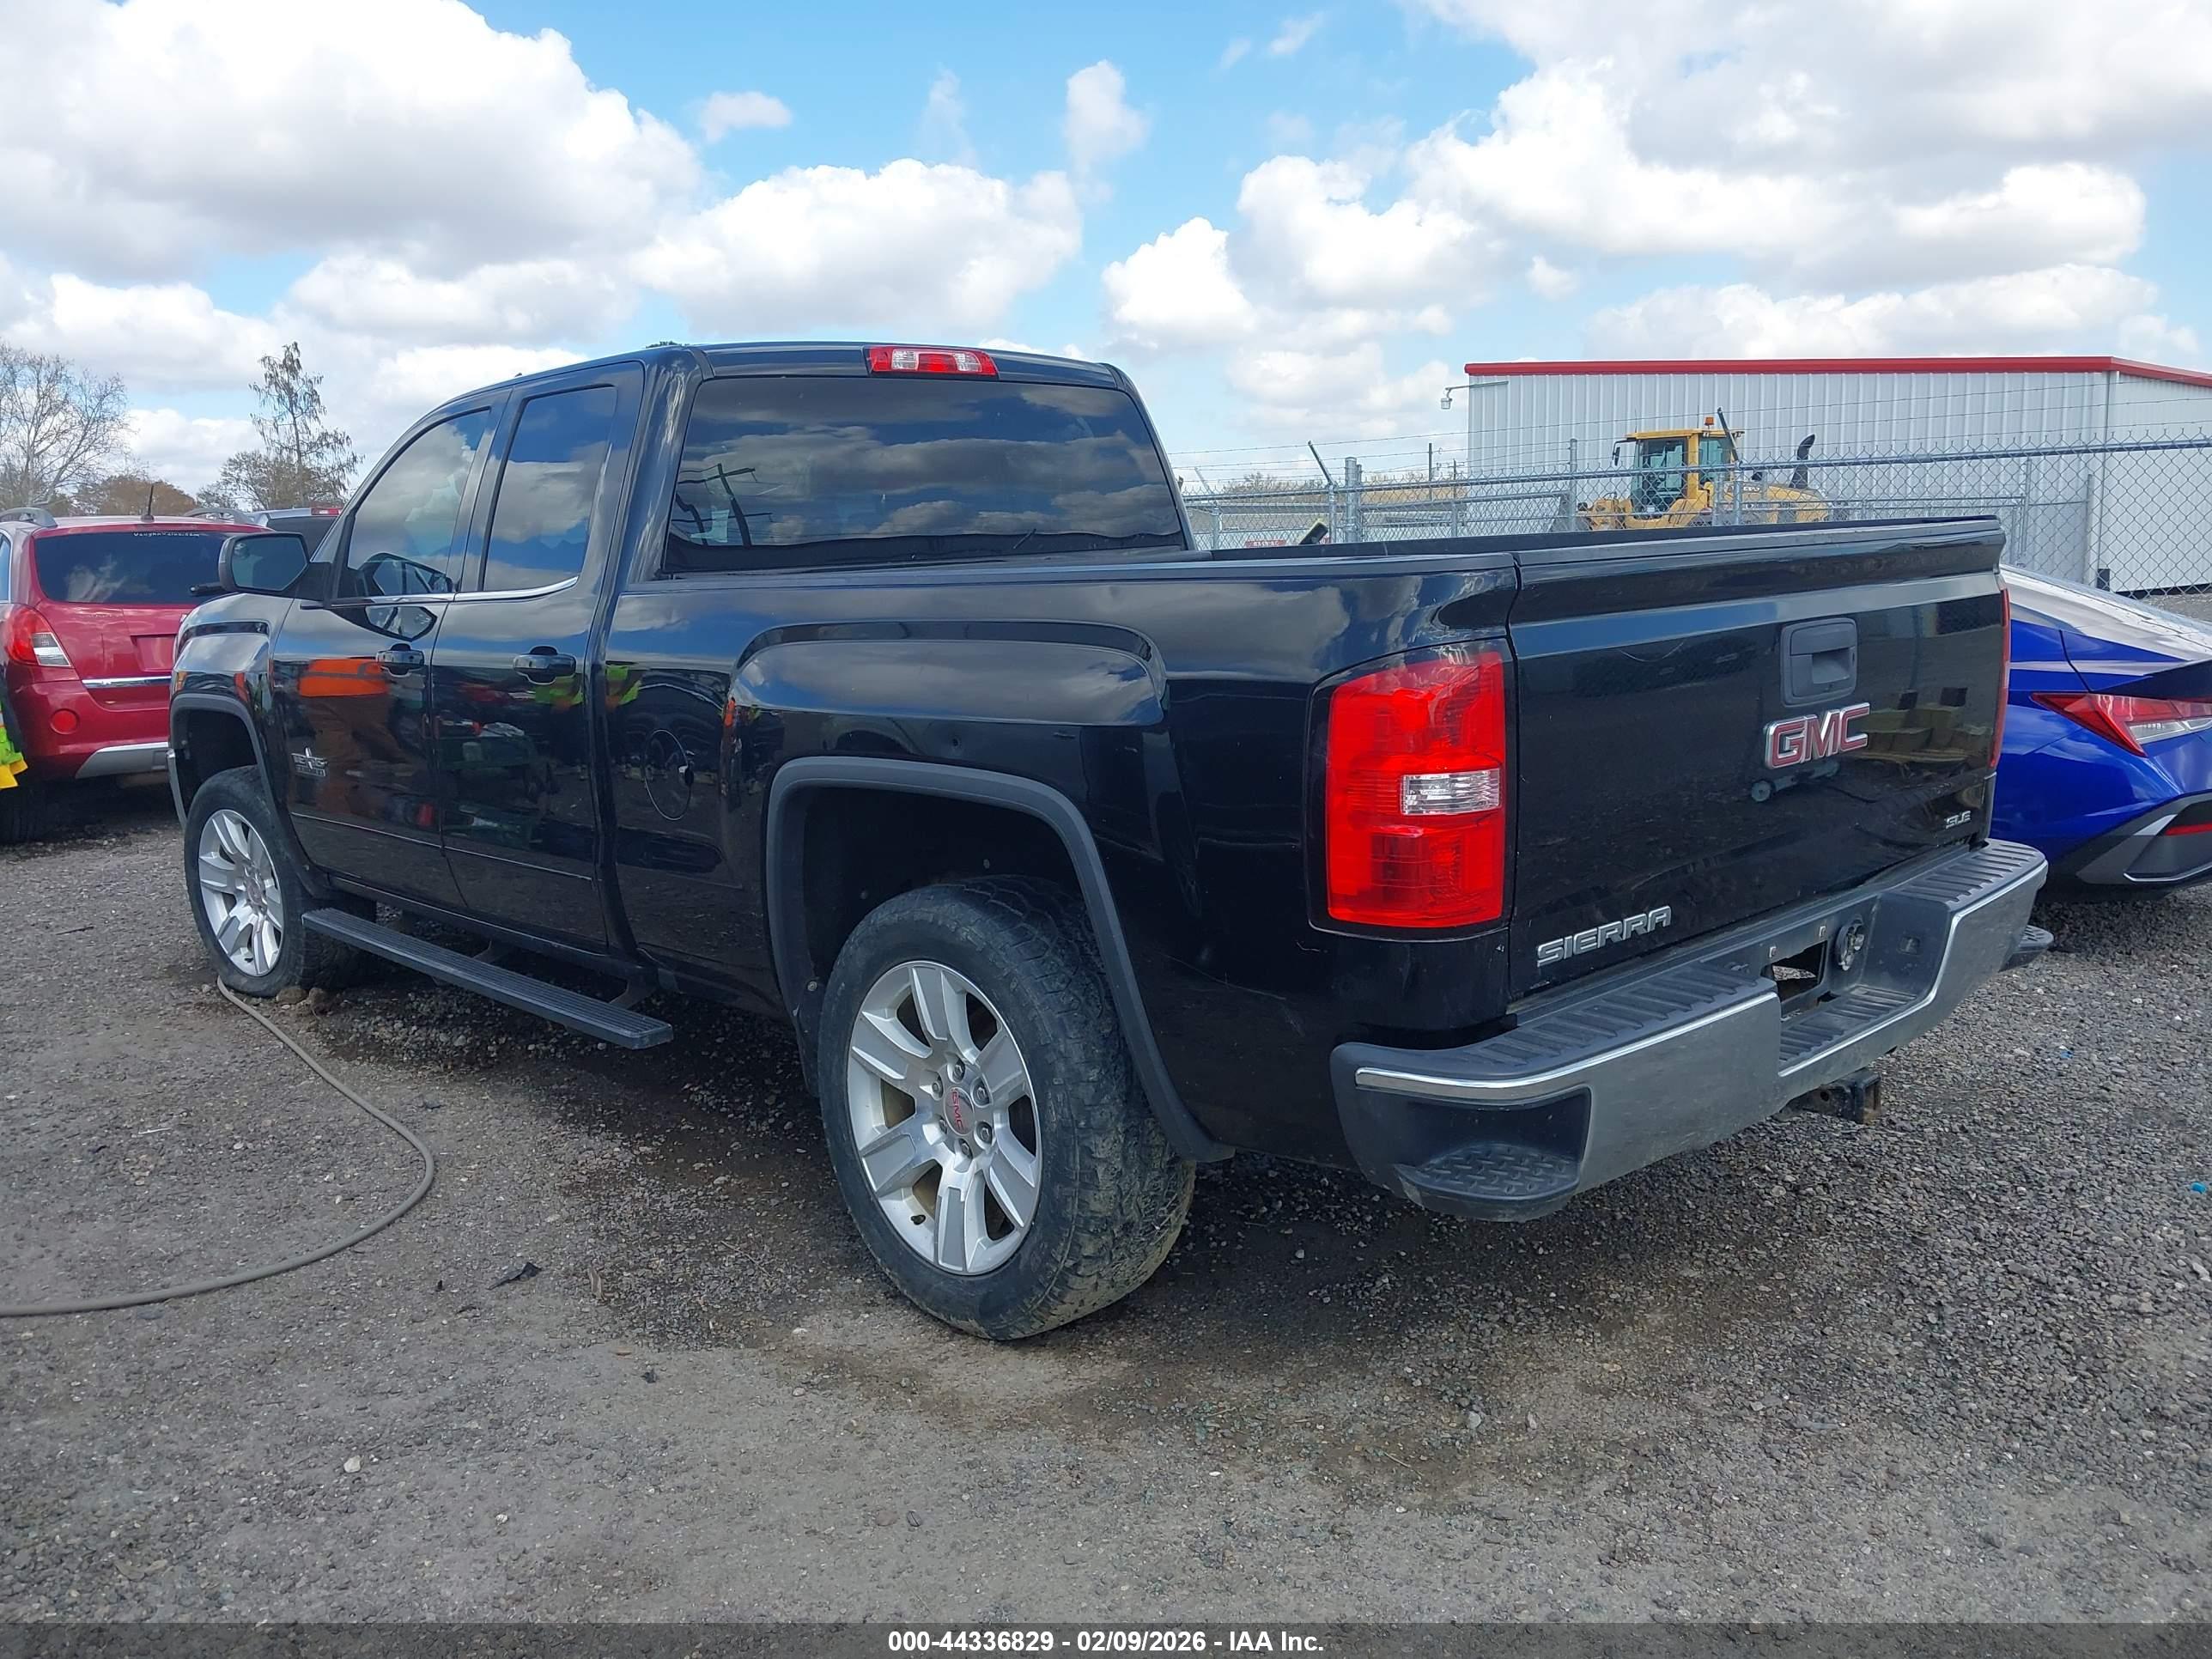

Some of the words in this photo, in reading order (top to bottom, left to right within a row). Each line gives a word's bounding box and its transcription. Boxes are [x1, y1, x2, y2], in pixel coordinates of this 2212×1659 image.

[1764, 702, 1870, 769] GMC
[1945, 810, 1972, 830] SLE
[1536, 905, 1672, 968] SIERRA
[951, 1090, 965, 1133] GMC
